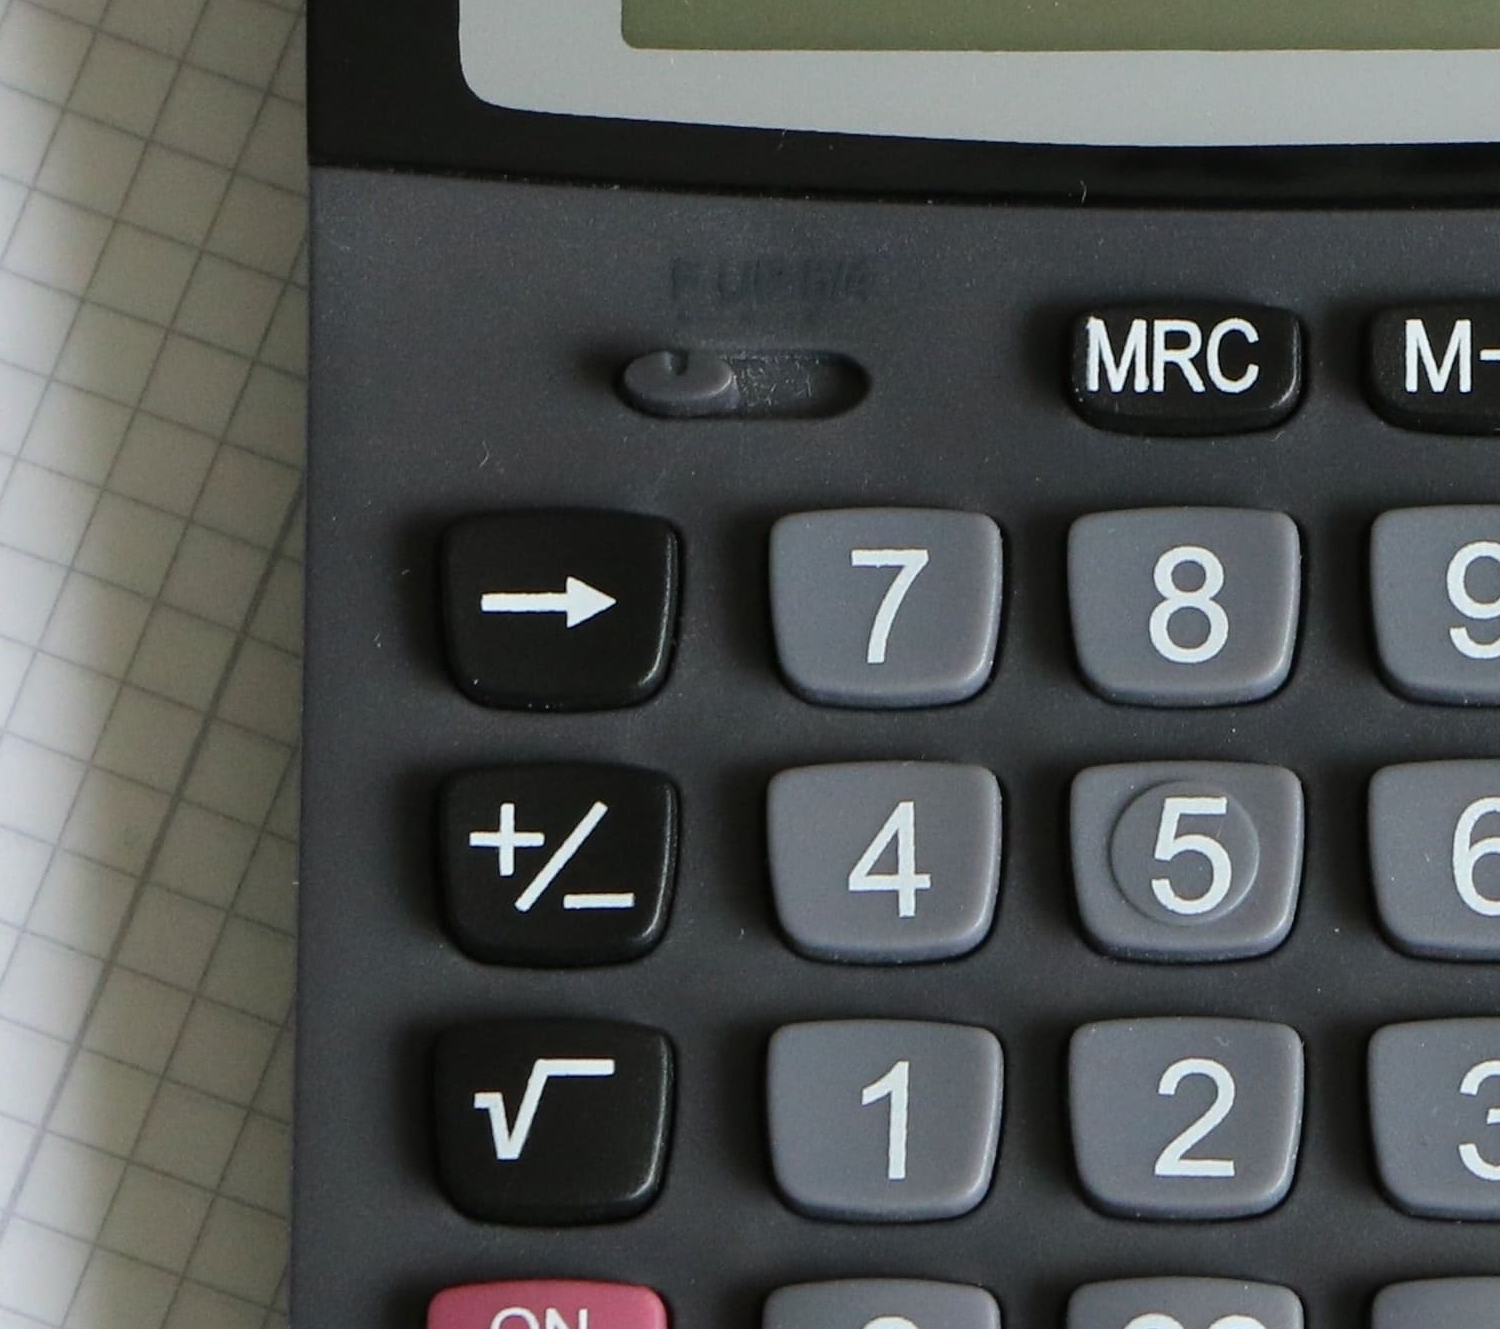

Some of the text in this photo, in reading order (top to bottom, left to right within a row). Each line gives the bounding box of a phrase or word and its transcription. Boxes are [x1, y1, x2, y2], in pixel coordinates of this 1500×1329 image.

[1086, 317, 1259, 393] MRC
[851, 549, 929, 663] 7
[1149, 546, 1229, 663] 8
[848, 801, 931, 917] 4
[1151, 797, 1232, 914] 5
[862, 1061, 910, 1179] 1
[1155, 1058, 1235, 1177] 2
